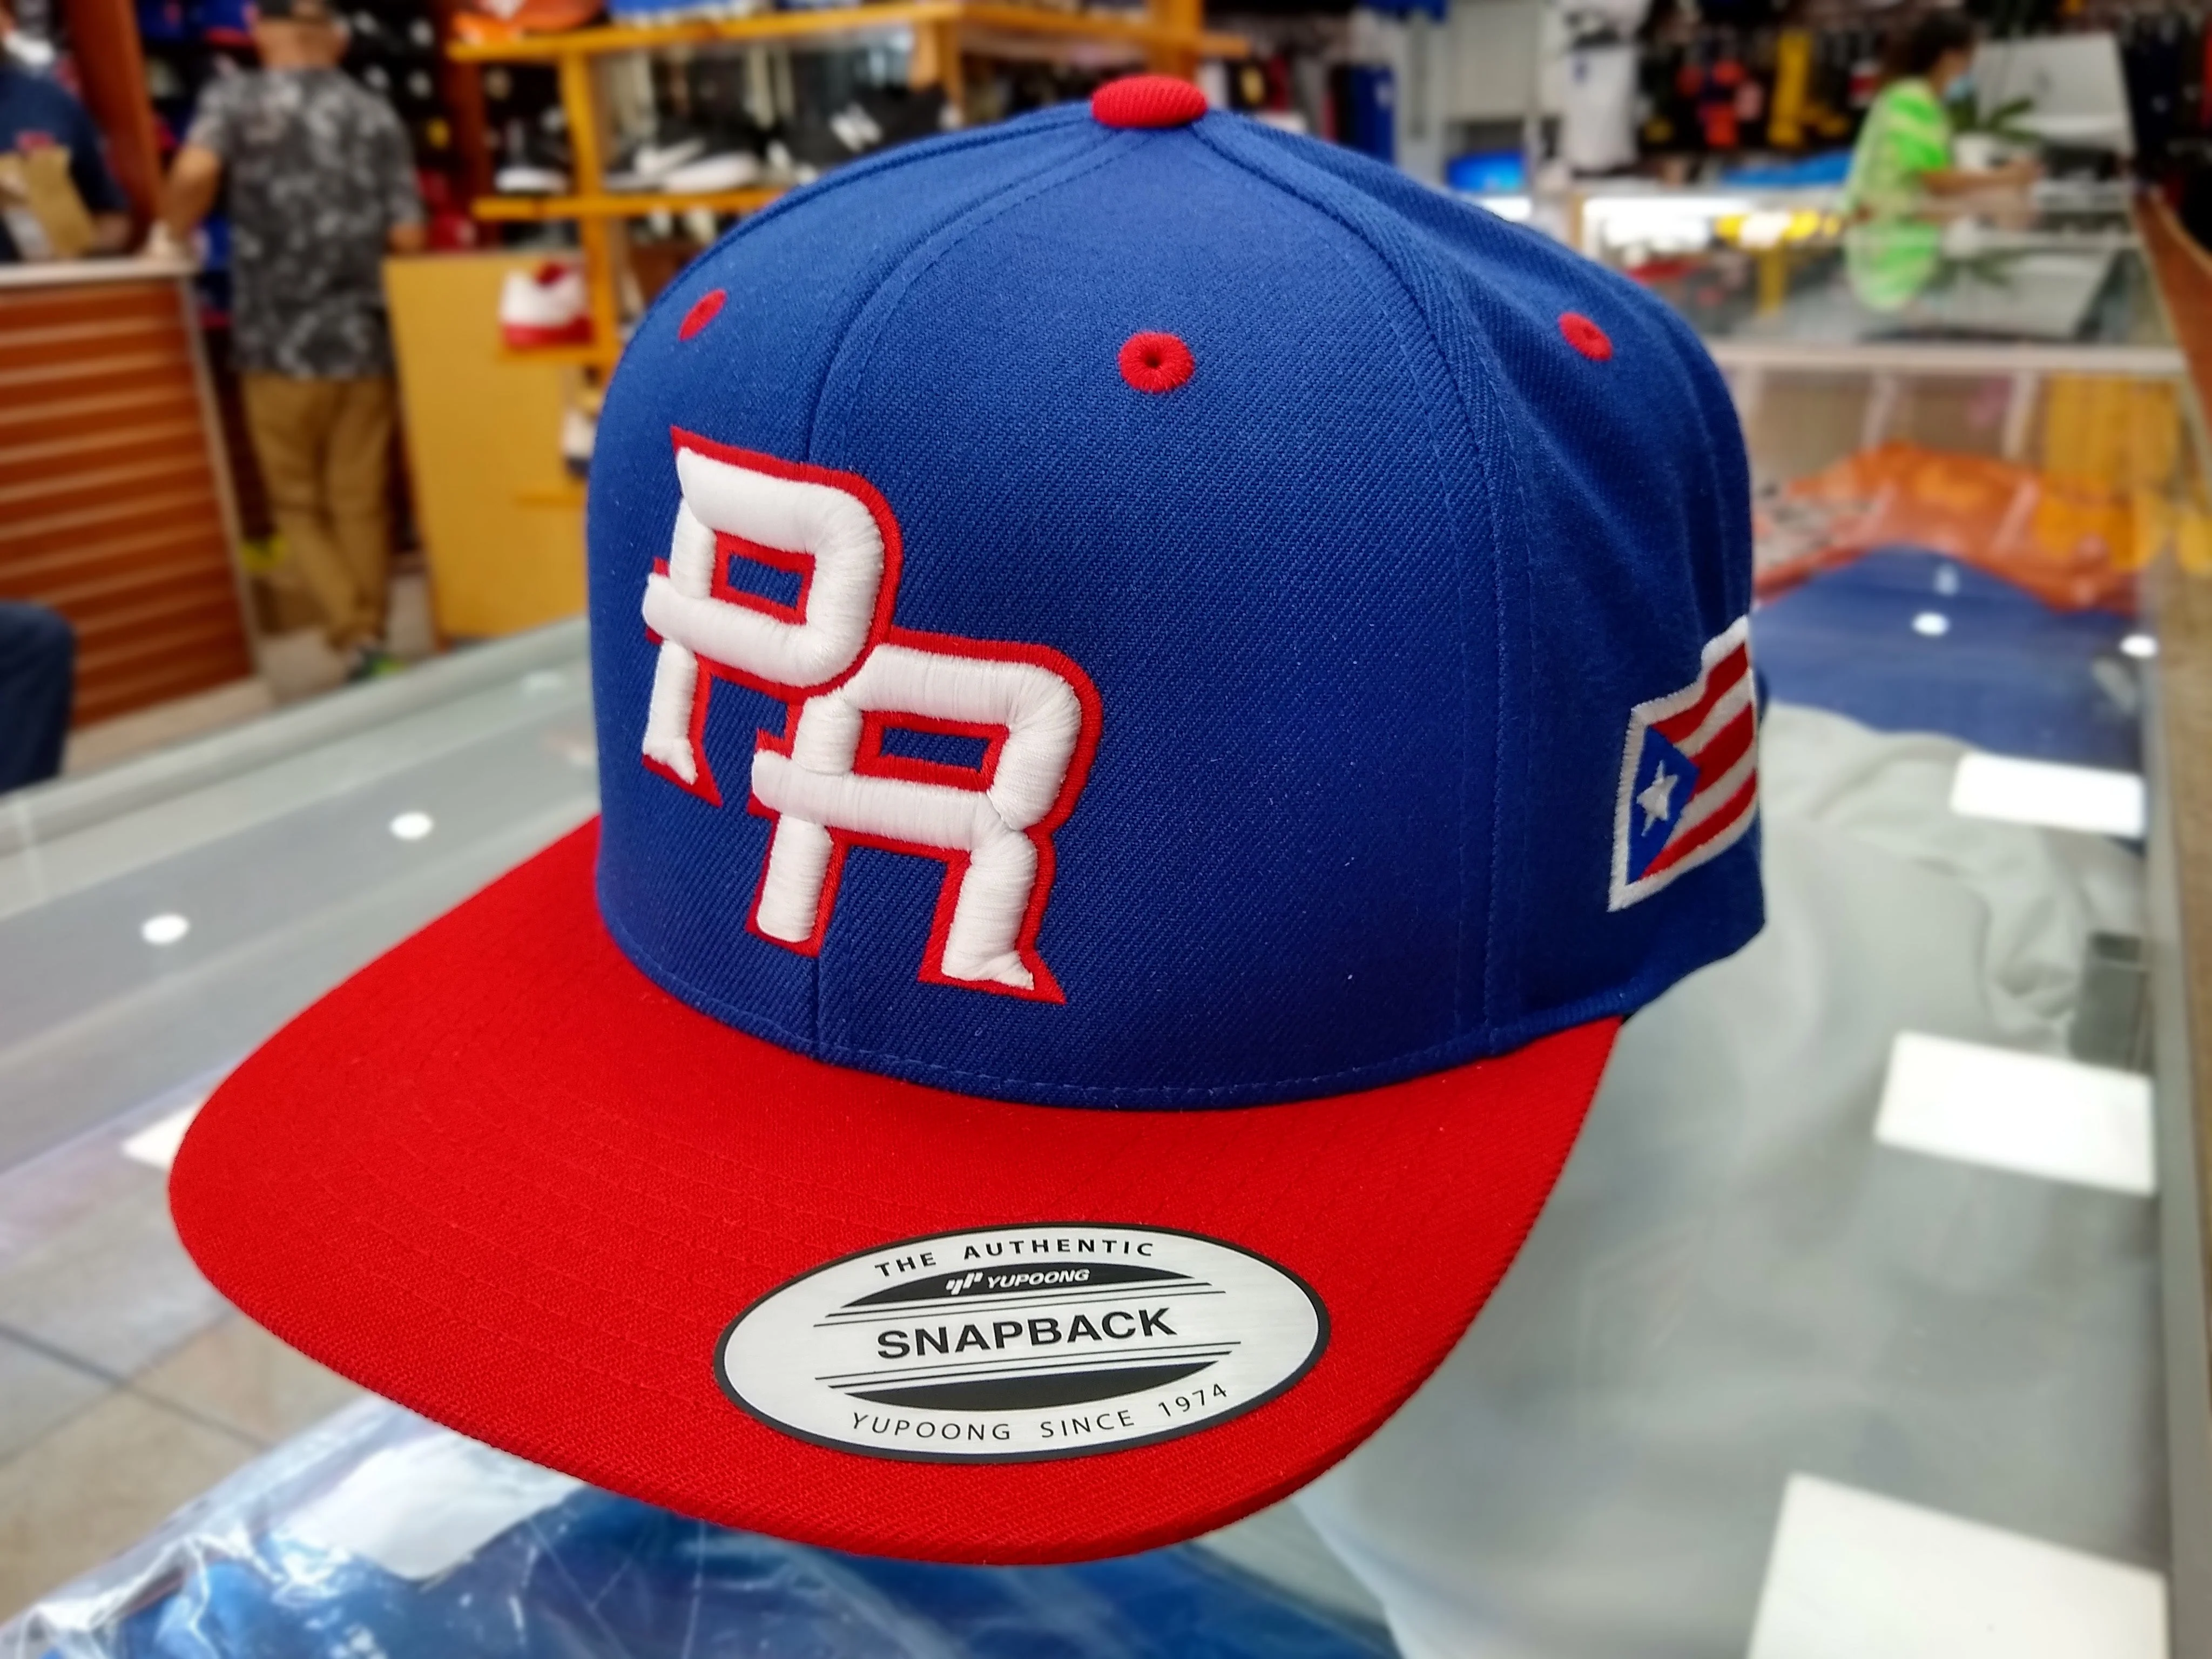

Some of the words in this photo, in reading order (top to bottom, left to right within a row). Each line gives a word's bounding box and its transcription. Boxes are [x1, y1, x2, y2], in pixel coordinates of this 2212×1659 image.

[875, 1252, 936, 1277] THE
[964, 1239, 1153, 1260] AUTHENTIC
[987, 1269, 1090, 1289] YUPOONG
[878, 1307, 1177, 1359] SNAPBACK
[853, 1412, 1010, 1441] YUPOONG
[1040, 1410, 1135, 1438] SINCE
[1158, 1383, 1228, 1417] 1974
